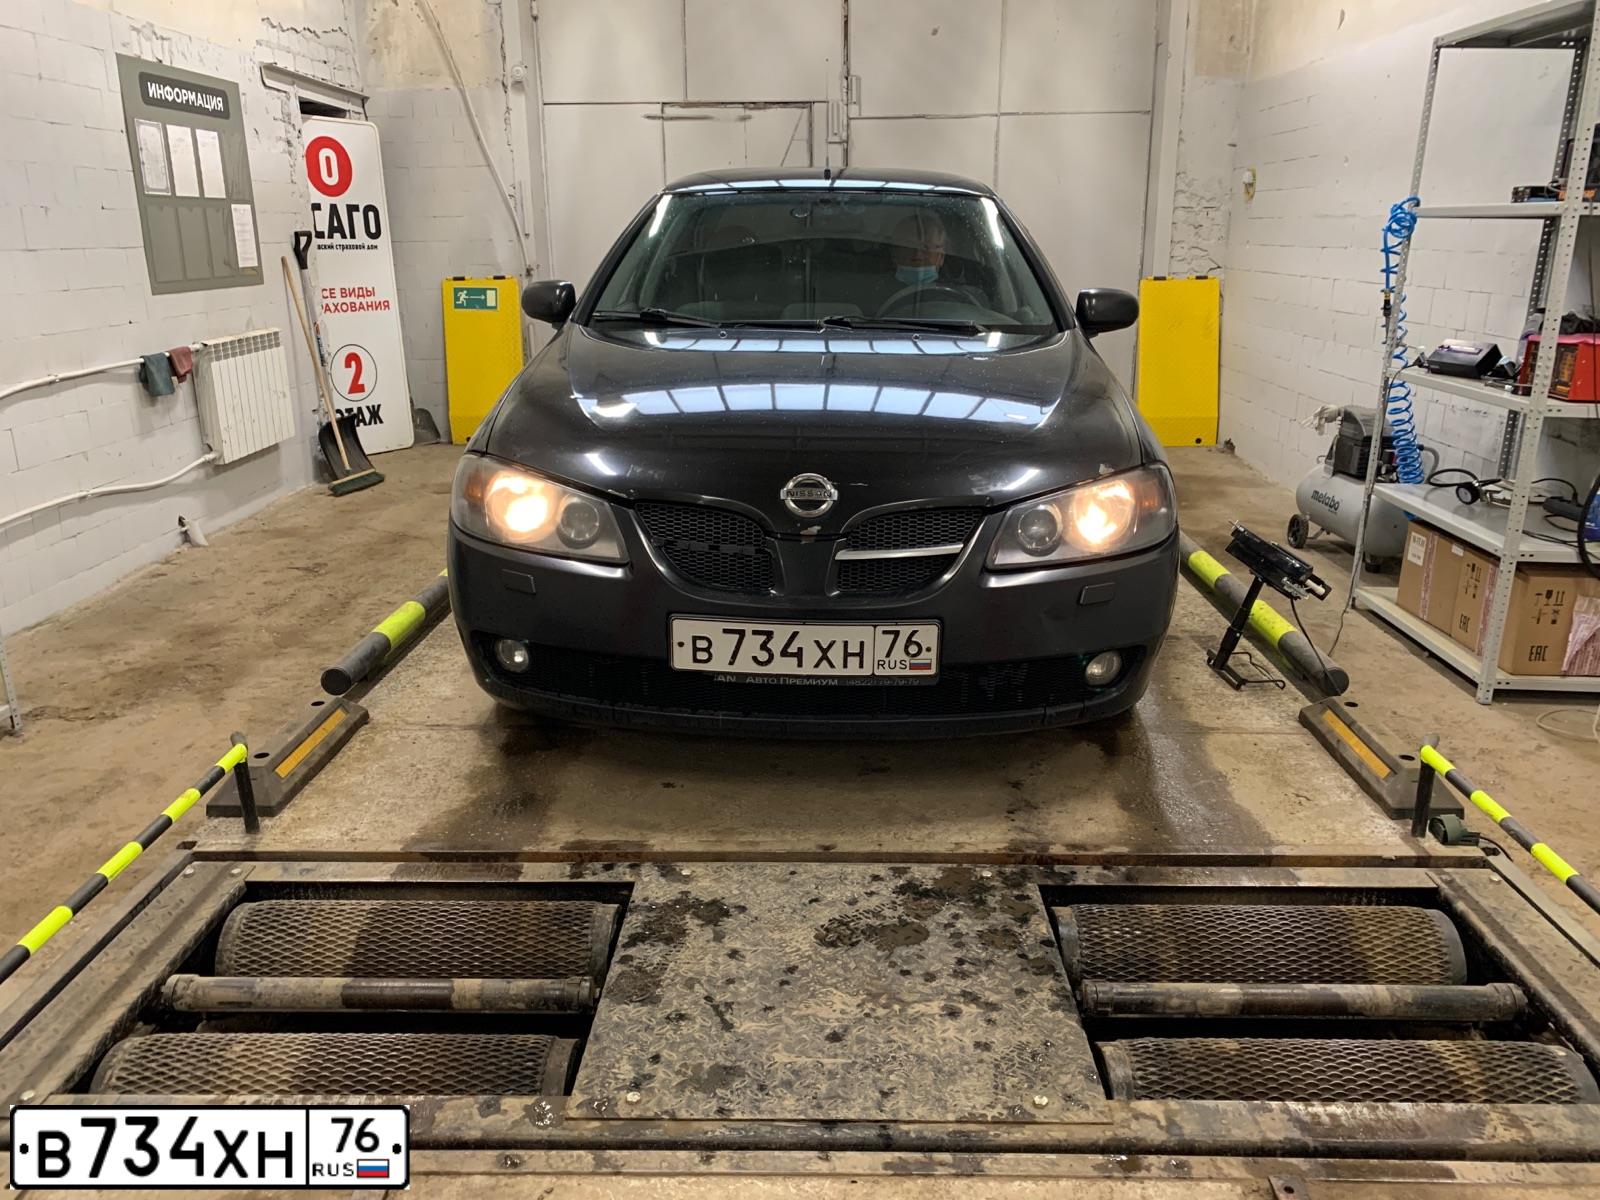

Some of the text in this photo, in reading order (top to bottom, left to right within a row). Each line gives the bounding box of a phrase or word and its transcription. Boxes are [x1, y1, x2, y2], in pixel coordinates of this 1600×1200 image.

[147, 81, 224, 112] ИНФОРМАЦИЯ
[335, 243, 366, 252] страховой
[340, 287, 376, 299] ВИДЫ
[321, 300, 391, 313] АХОВАНИЯ
[344, 351, 366, 395] 2
[786, 489, 832, 498] NISSAN
[1311, 490, 1340, 511] metabo
[691, 628, 923, 669] В734ХН 76
[877, 659, 908, 670] RUS
[714, 674, 737, 682] AN
